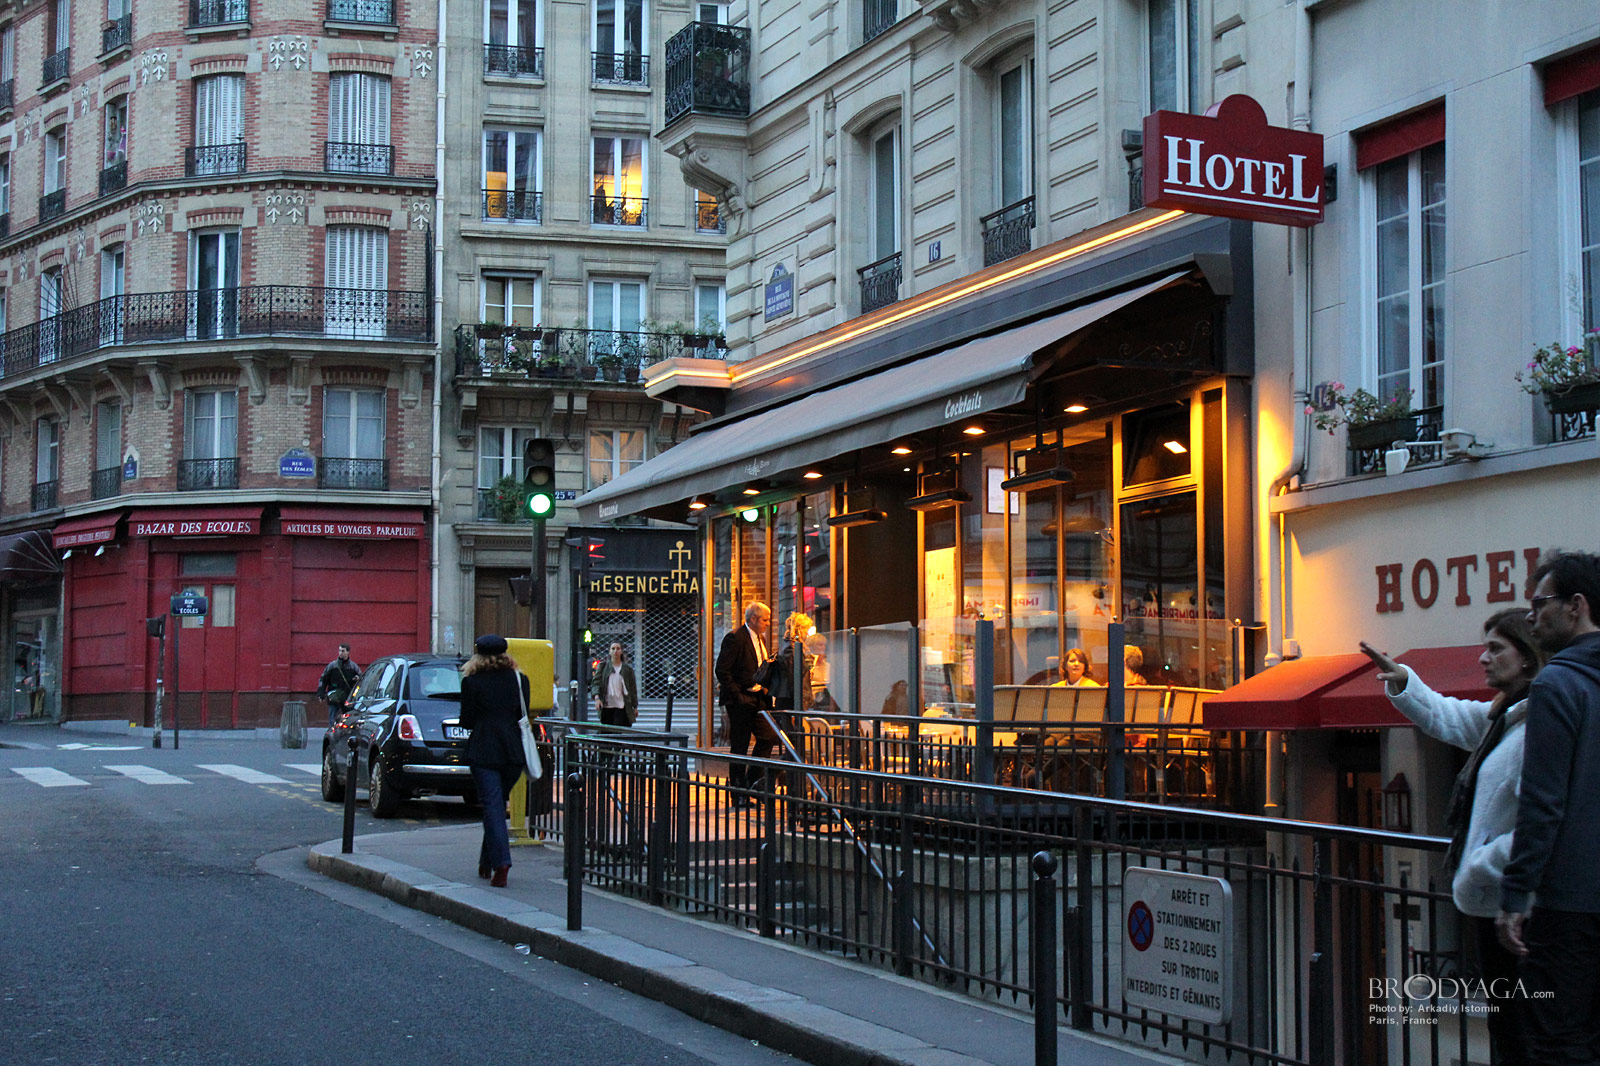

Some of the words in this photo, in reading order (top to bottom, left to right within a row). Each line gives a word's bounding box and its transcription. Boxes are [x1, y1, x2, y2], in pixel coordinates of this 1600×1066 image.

[1163, 135, 1320, 204] HOTEL
[930, 241, 939, 261] 16
[945, 391, 982, 419] Cocktails
[554, 491, 566, 499] 25
[137, 523, 175, 535] BAZAR
[180, 522, 202, 534] DES
[206, 521, 251, 533] ECOLES
[286, 524, 322, 534] ARTICLES
[324, 525, 335, 534] DE
[376, 526, 419, 536] PARAPLUIE
[578, 574, 669, 594] RESENCE
[1171, 888, 1197, 905] ARRÊT
[1199, 893, 1210, 907] ET
[1156, 911, 1221, 934] STATIONNEMENT
[1164, 936, 1180, 951] DES
[1182, 941, 1188, 953] 2
[1190, 942, 1217, 958] ROUES
[1161, 960, 1178, 975] SUR
[1181, 964, 1220, 985] TROTTOIR
[1127, 977, 1168, 997] INTERDITS
[1170, 987, 1180, 1000] ET
[1182, 987, 1221, 1010] GÊNANTS
